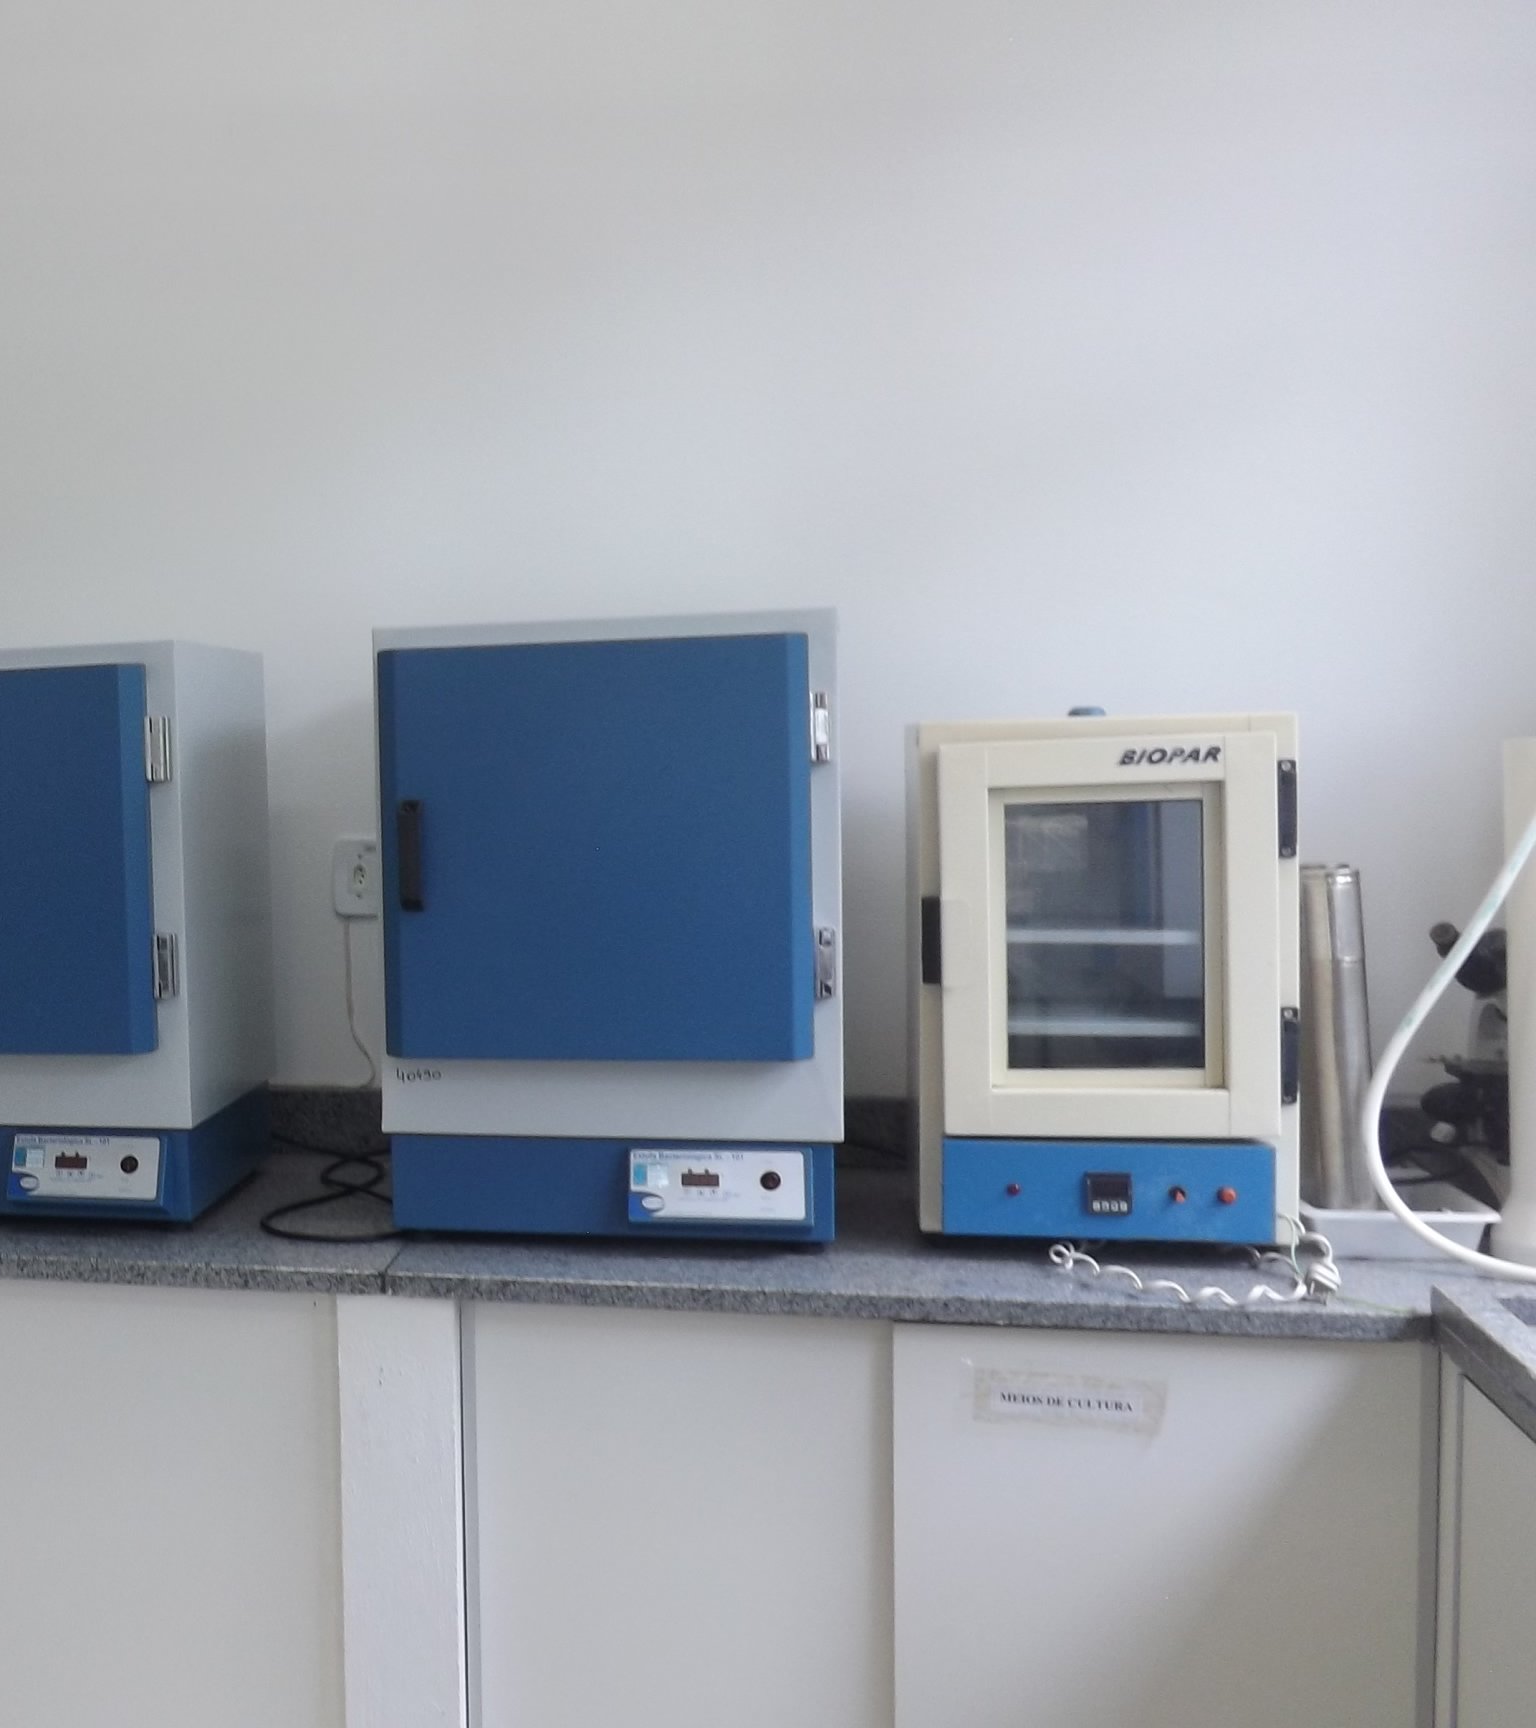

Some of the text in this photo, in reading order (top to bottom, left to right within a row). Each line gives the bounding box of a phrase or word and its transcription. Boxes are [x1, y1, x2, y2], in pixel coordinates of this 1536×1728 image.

[1119, 746, 1221, 766] BIOPAR
[1000, 1392, 1132, 1413] MEIOS DE CULTURA
